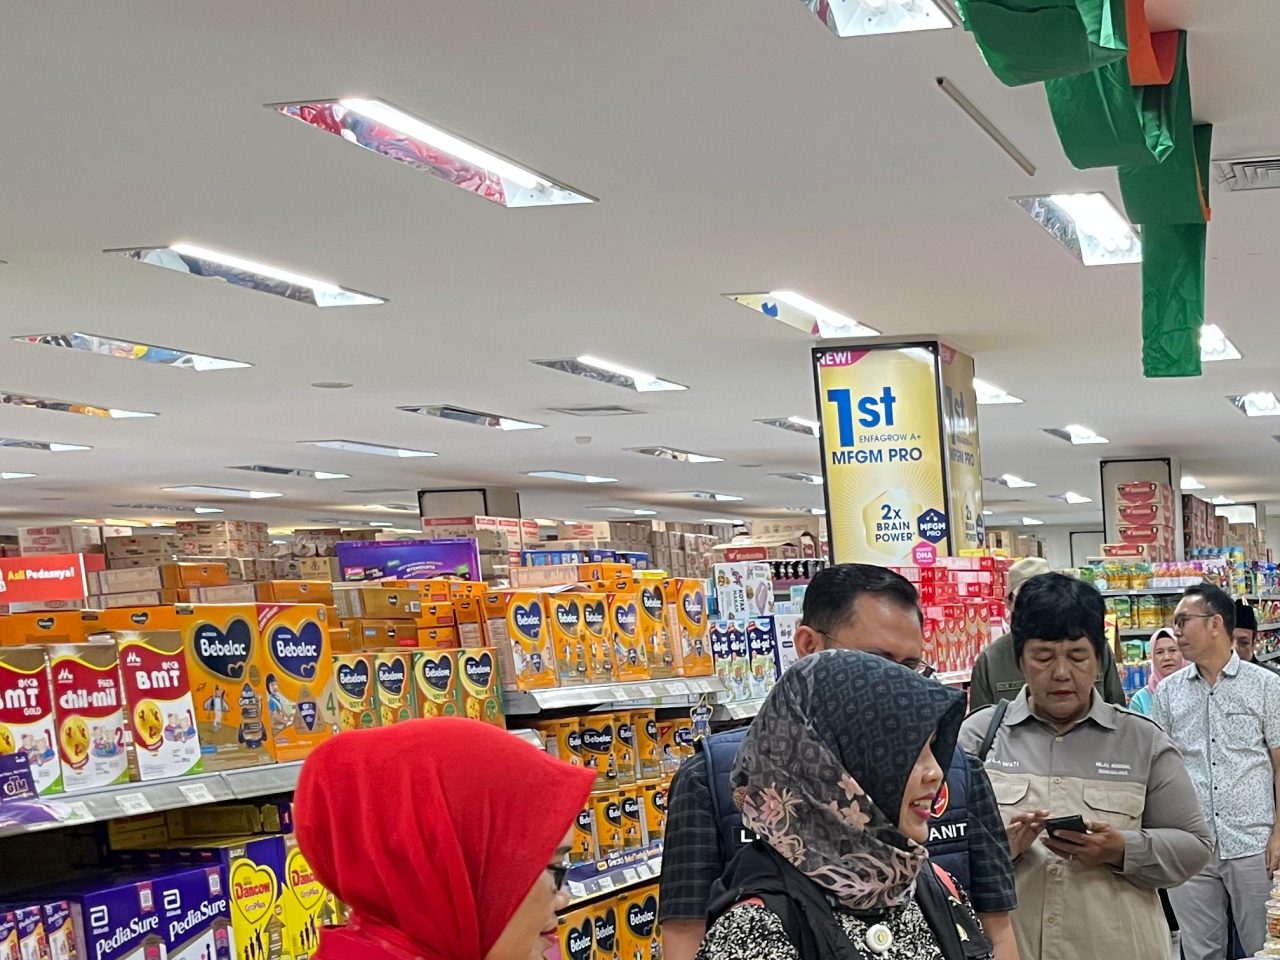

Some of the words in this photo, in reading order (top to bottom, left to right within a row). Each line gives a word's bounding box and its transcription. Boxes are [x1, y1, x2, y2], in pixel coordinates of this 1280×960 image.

[827, 386, 896, 448] 1st
[859, 433, 907, 444] ENFAGROW
[832, 449, 884, 465] MFGM
[889, 447, 923, 462] PRO
[876, 521, 911, 532] BRAIN
[919, 522, 946, 531] MFGM
[916, 550, 933, 559] DHA
[26, 567, 75, 582] Pedasnya!
[200, 638, 247, 657] Bebelac
[276, 640, 318, 657] Bebelac
[135, 669, 182, 690] BMT
[235, 880, 271, 899] Dancow
[168, 898, 226, 942] PediaSure
[95, 914, 160, 960] PediaSure
